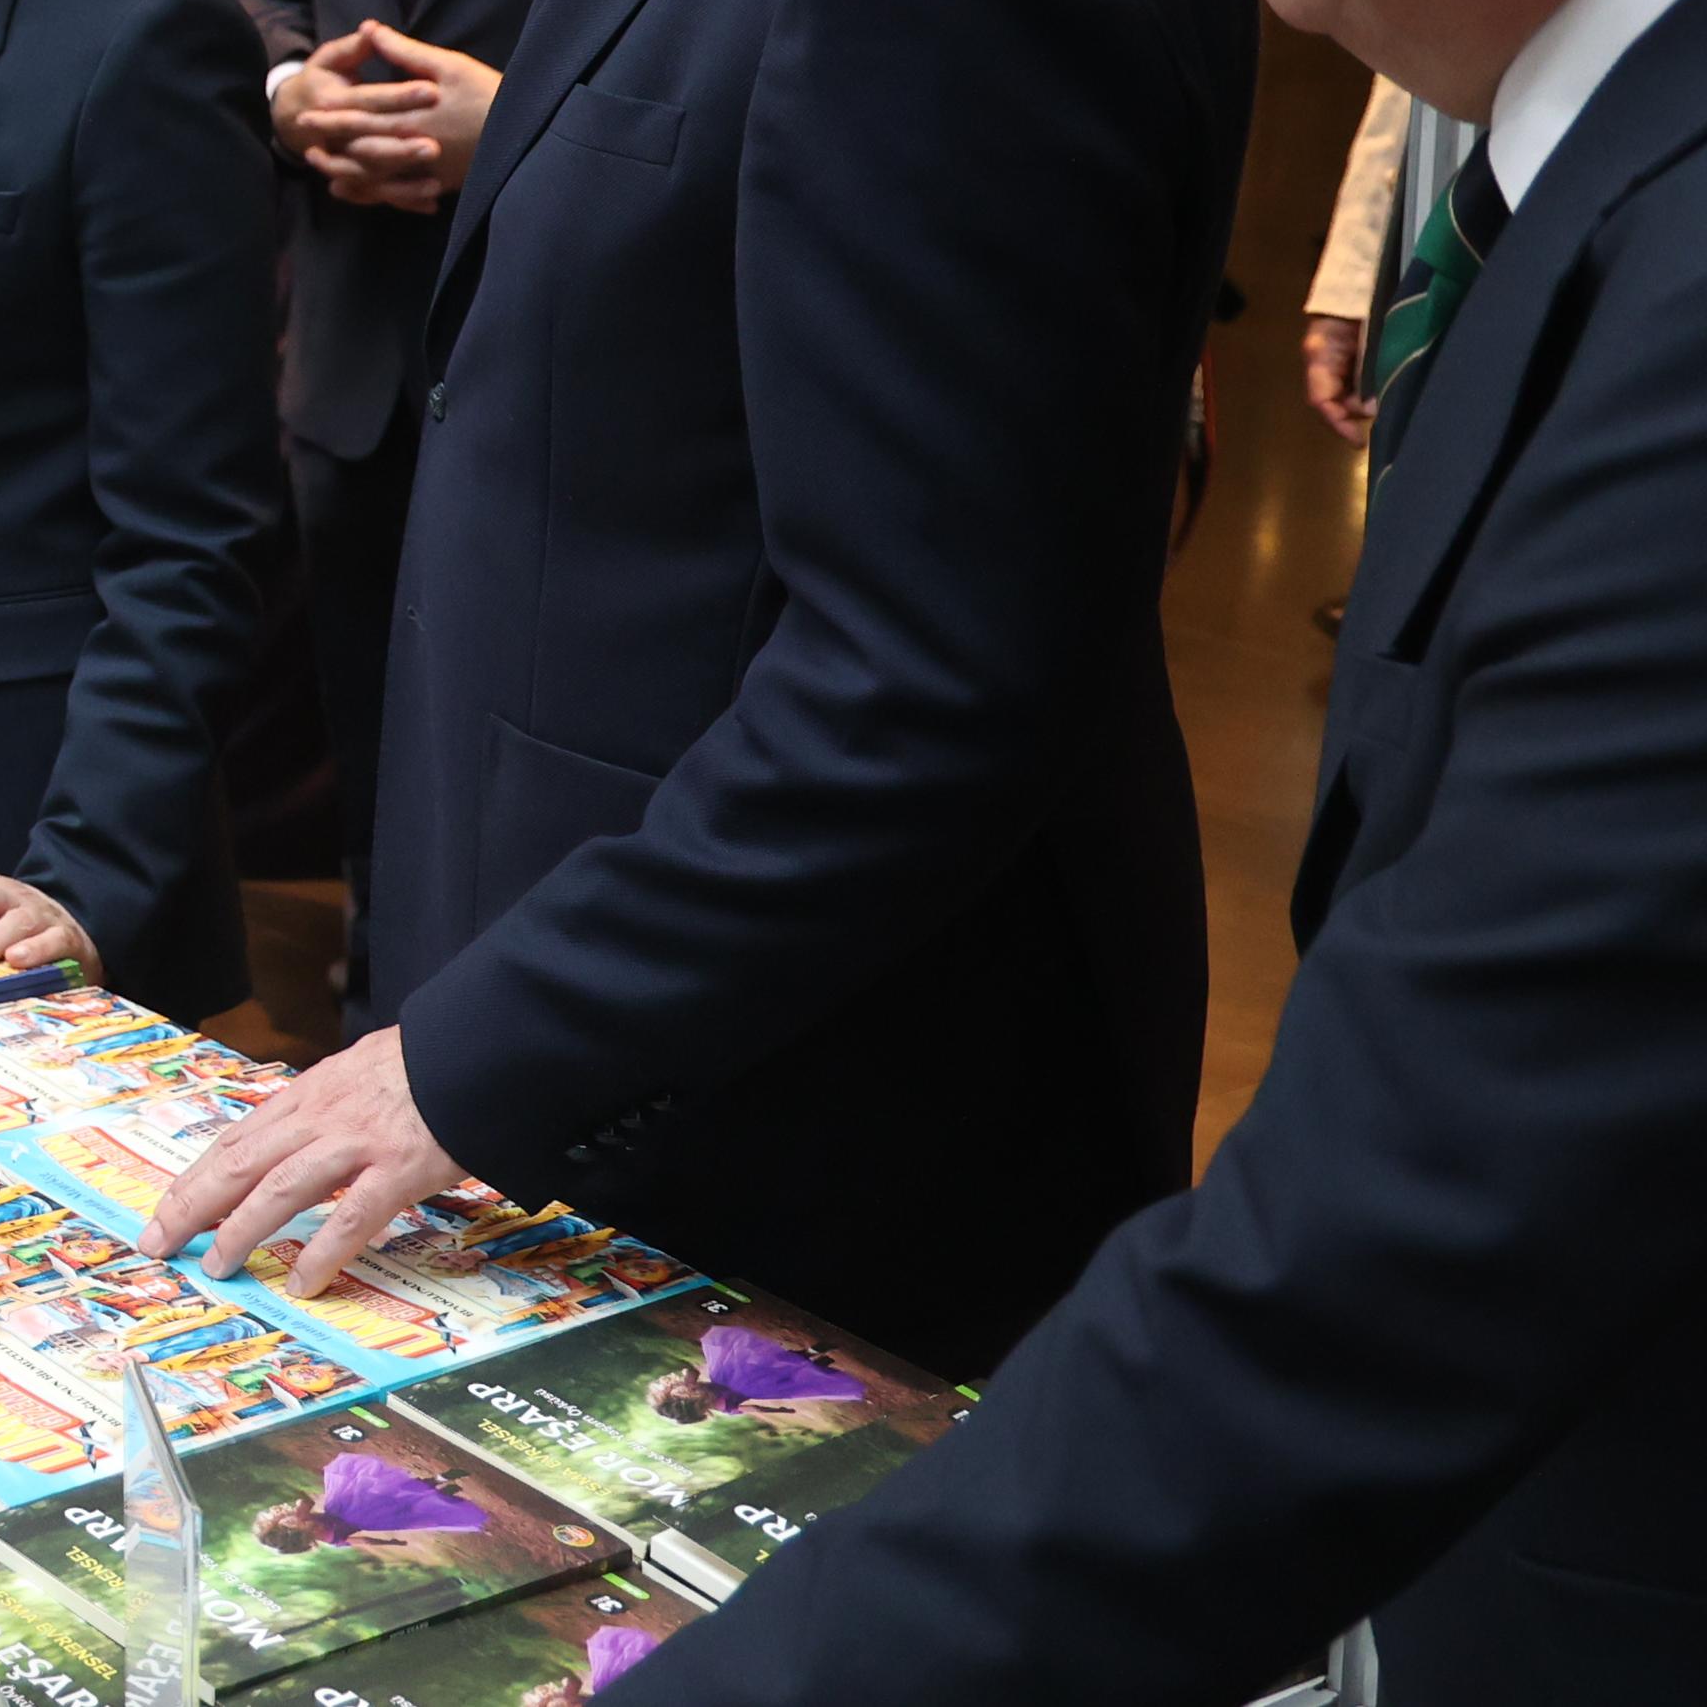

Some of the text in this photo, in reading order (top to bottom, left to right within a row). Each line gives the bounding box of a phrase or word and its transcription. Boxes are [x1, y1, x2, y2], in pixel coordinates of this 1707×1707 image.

[466, 1382, 692, 1513] MOR EŞARP
[477, 1417, 613, 1497] ESMA EVRENSEL
[33, 1620, 120, 1683] EVRENSEL
[198, 1580, 287, 1652] MO
